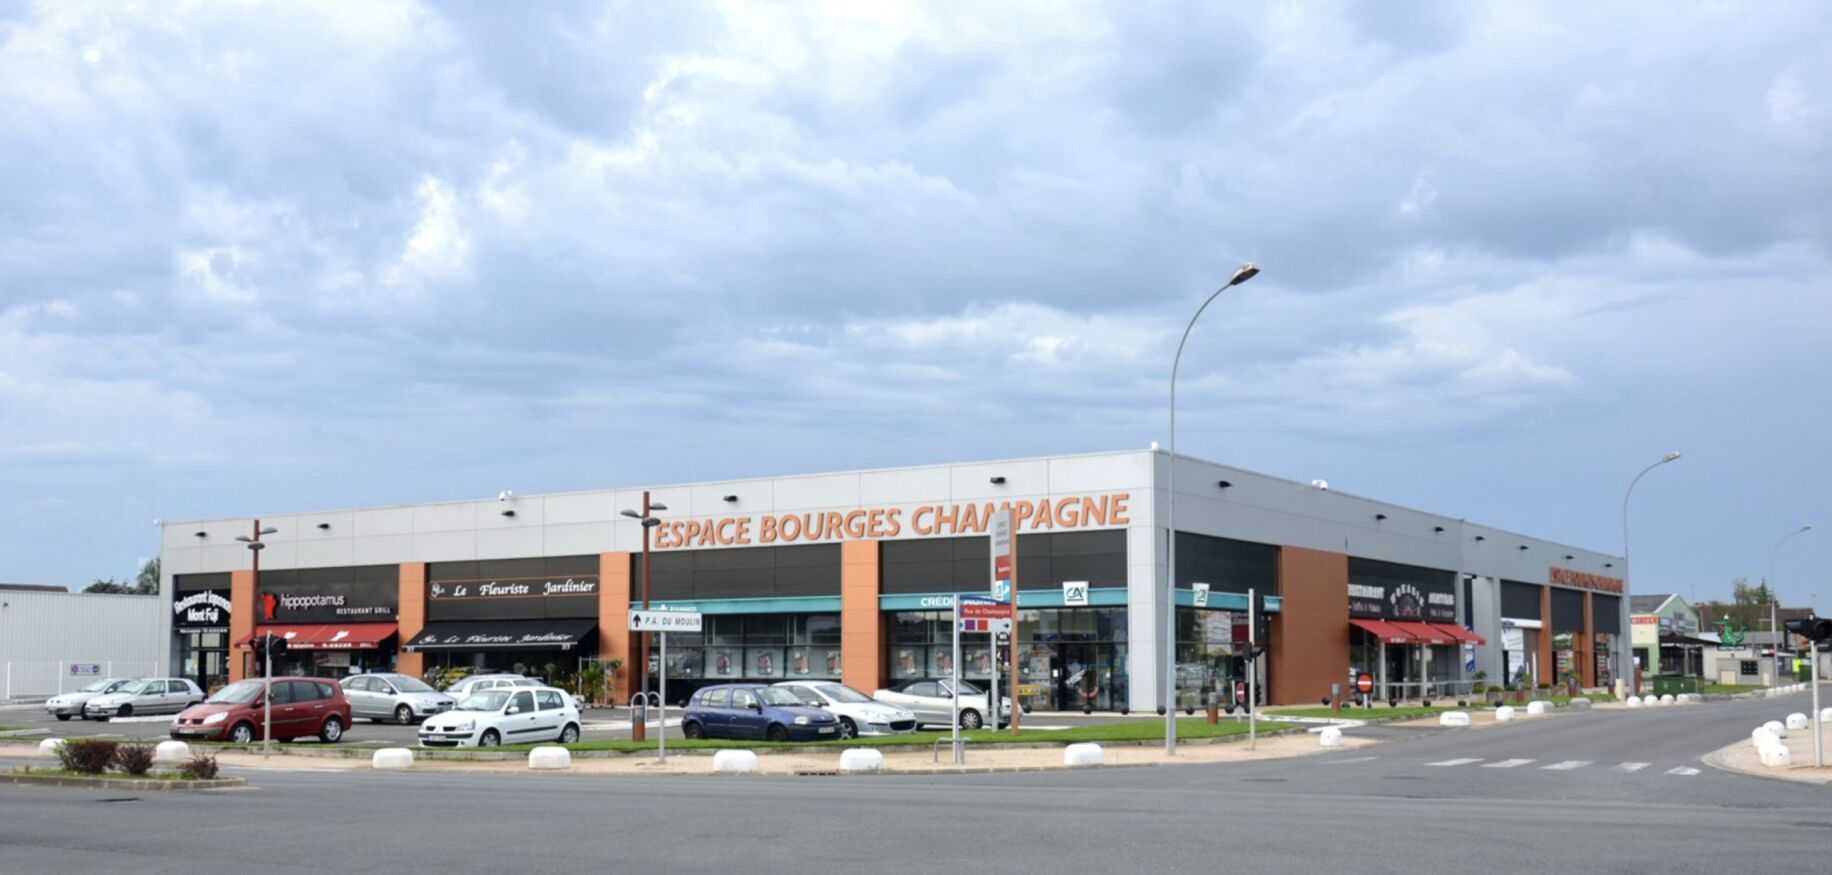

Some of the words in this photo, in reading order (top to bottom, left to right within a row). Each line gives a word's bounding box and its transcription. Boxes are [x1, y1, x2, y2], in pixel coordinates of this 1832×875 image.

[655, 517, 752, 548] ESPACE
[759, 508, 901, 543] BOURGES
[911, 493, 1130, 536] CHAMPAGNE
[453, 585, 467, 597] Le
[479, 582, 529, 596] Fleuriste
[542, 578, 596, 596] Jardinier
[281, 593, 345, 610] hippopotamus
[336, 607, 372, 615] RESTAURANT
[983, 608, 1010, 616] Champagne
[662, 617, 672, 625] DU
[675, 617, 700, 626] MOULIN
